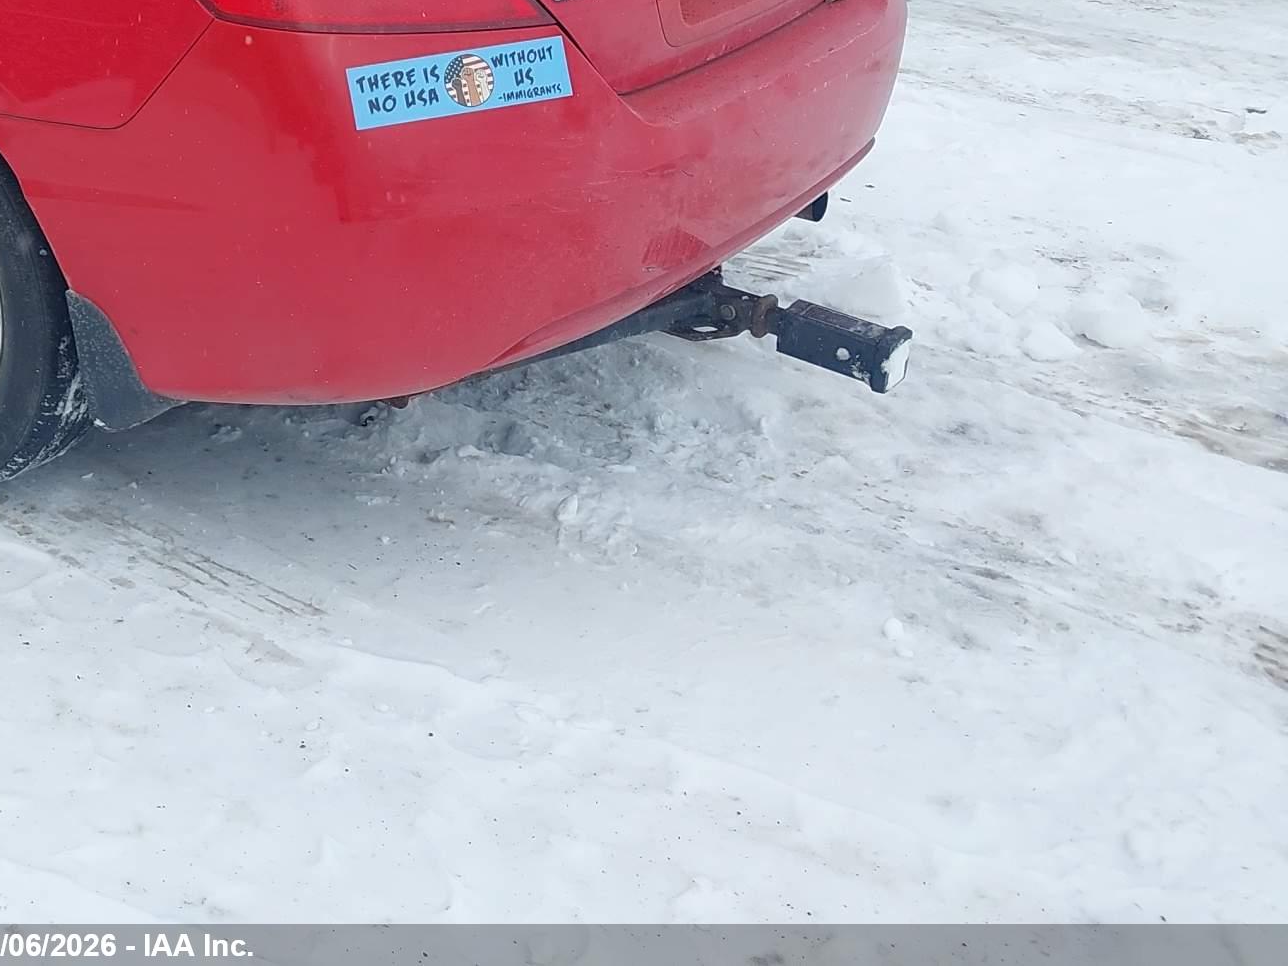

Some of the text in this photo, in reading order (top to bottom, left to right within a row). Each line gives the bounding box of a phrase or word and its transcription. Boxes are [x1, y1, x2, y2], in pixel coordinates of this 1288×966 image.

[490, 45, 554, 68] WITHOUT
[355, 64, 441, 94] THERE IS
[514, 67, 534, 87] US
[368, 88, 440, 115] NO USA
